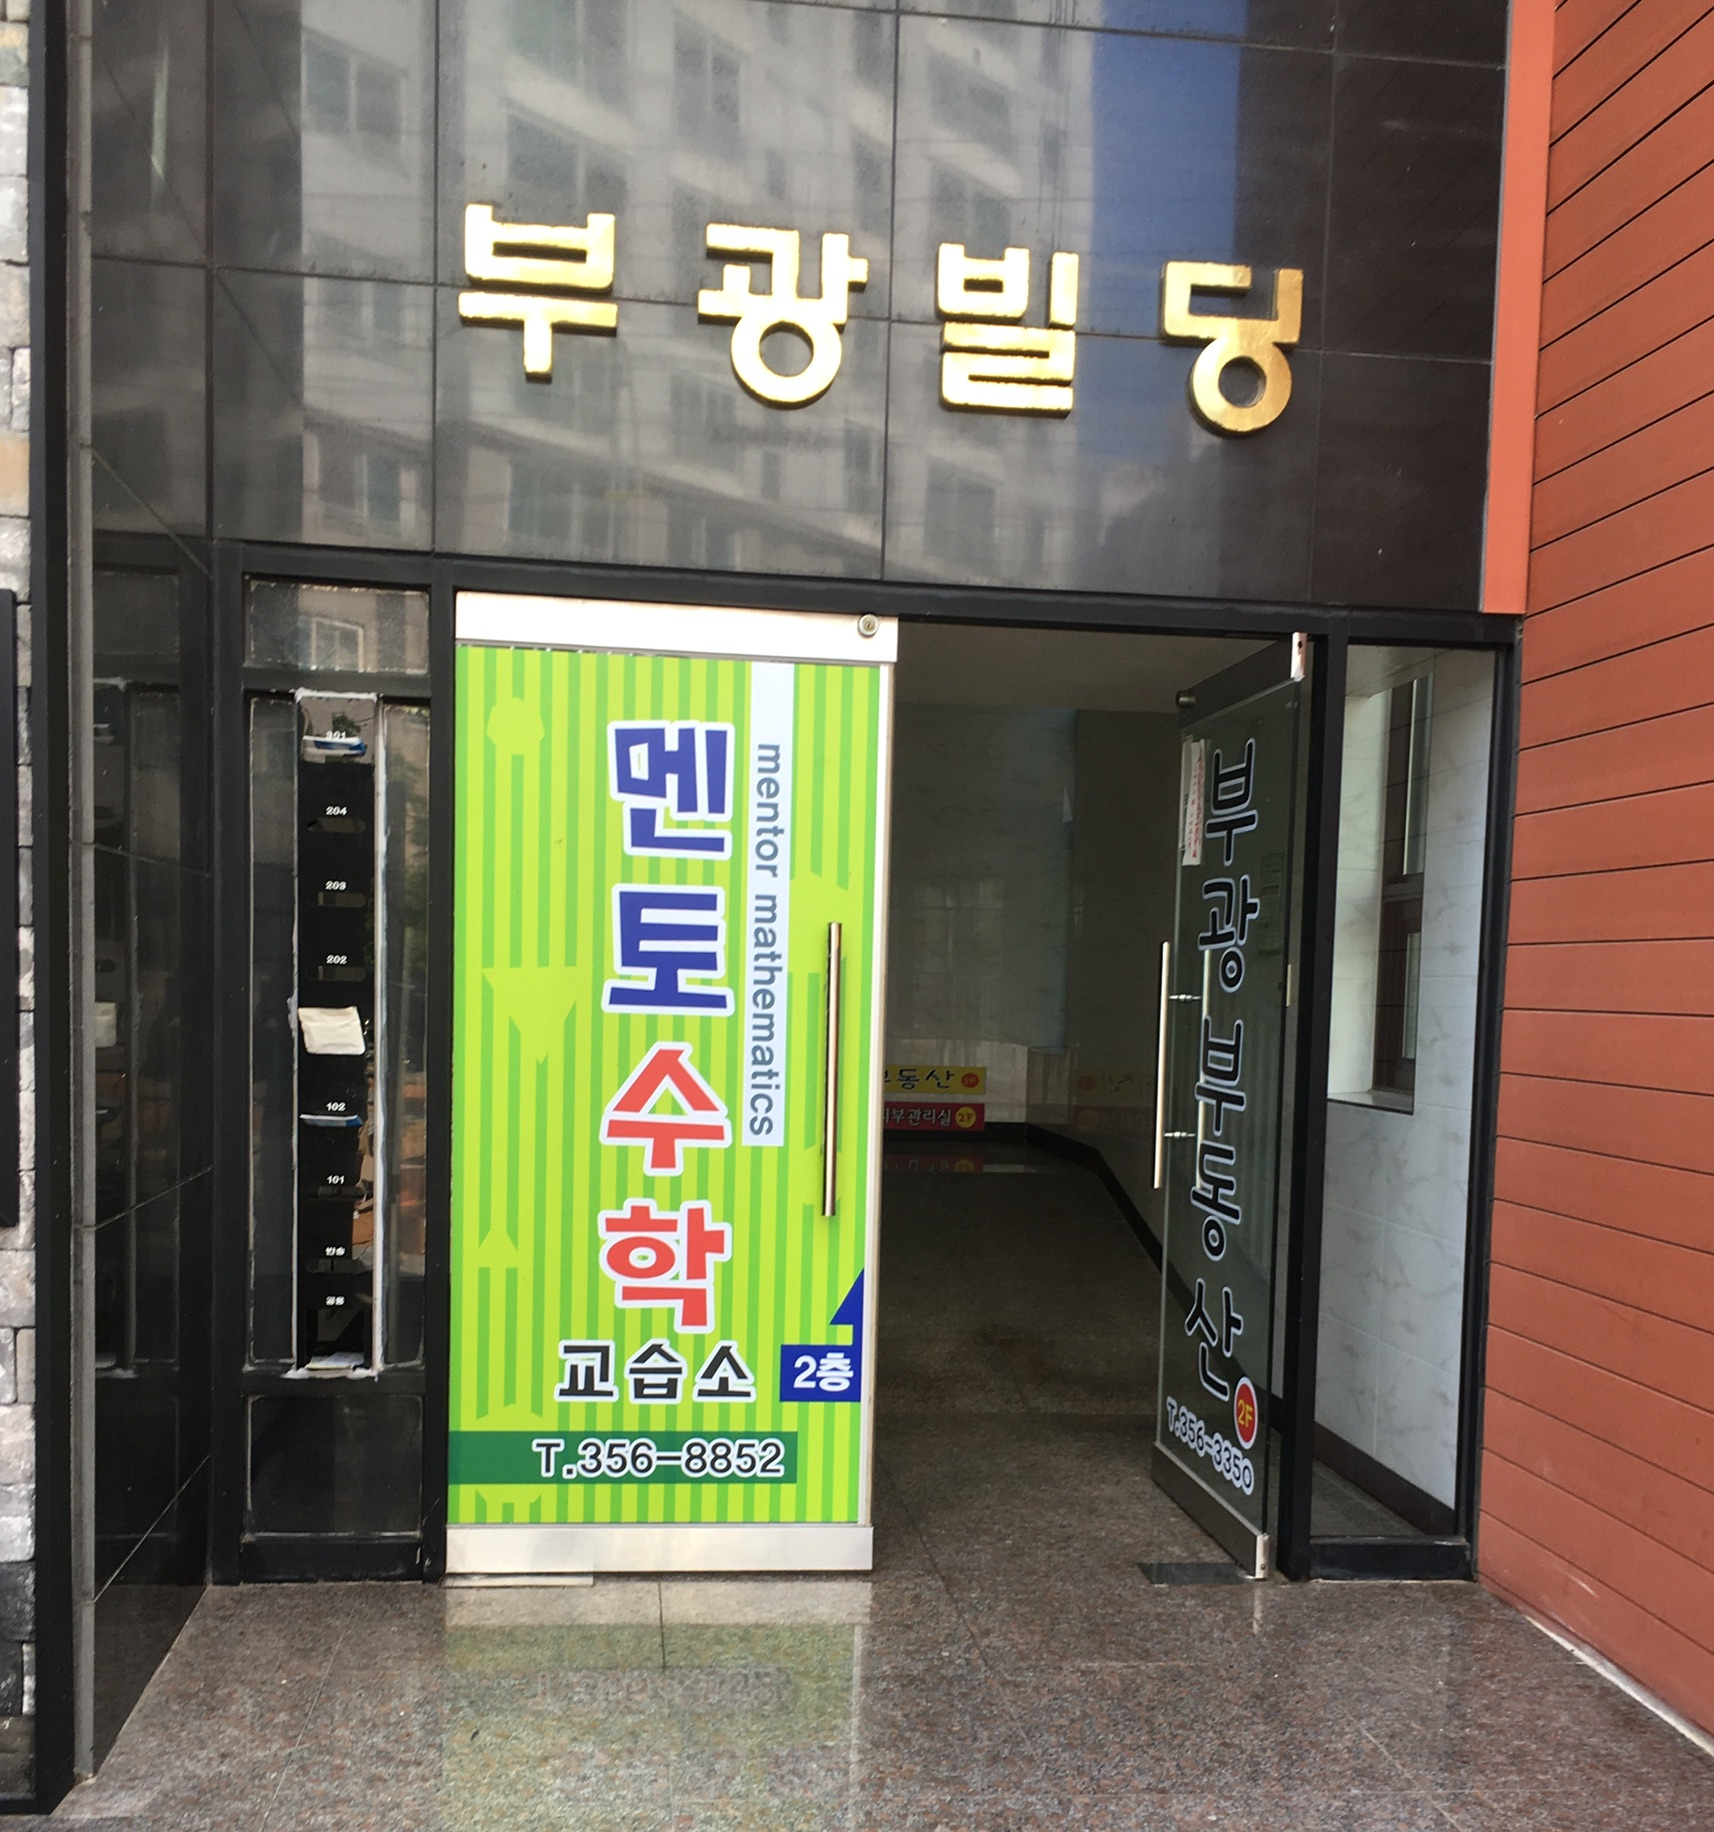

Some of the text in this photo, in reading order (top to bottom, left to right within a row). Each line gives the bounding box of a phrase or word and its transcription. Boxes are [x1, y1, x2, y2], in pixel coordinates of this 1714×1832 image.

[458, 204, 1304, 434] 부광빌딩
[325, 805, 348, 816] 204
[325, 880, 347, 891] 203
[749, 743, 785, 1136] mentor mathematics
[326, 954, 348, 965] 202
[326, 1101, 347, 1112] 102
[957, 1113, 976, 1123] 2F
[326, 1174, 345, 1185] 101
[556, 1340, 754, 1402] 교습소
[794, 1352, 854, 1392] 2층
[1237, 1399, 1254, 1428] 2F
[534, 1439, 783, 1477] T.356-8852
[1167, 1397, 1254, 1494] T.356-3350
